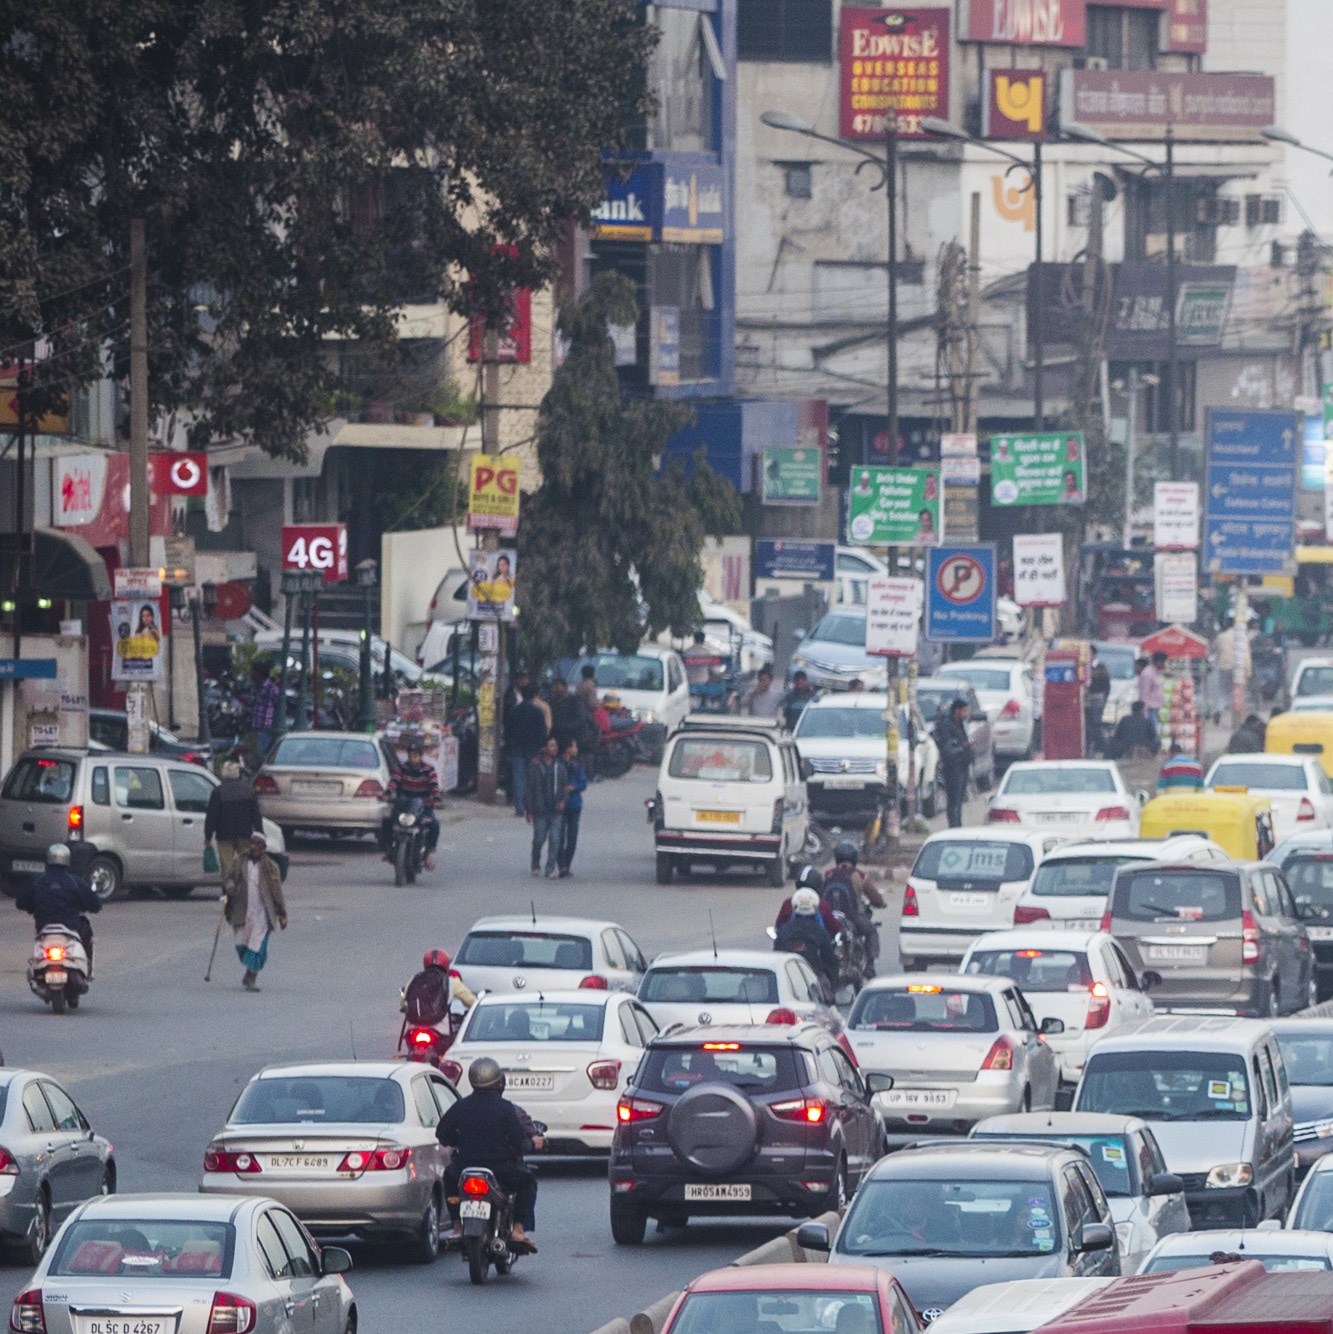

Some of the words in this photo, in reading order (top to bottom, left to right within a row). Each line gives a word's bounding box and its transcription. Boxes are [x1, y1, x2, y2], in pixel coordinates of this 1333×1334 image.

[851, 28, 939, 58] EDWISE
[851, 61, 939, 76] OVERSEAS
[851, 78, 939, 92] EDUCATION
[590, 192, 645, 222] ank
[475, 465, 518, 496] PG
[287, 537, 334, 569] 4G
[933, 611, 948, 621] No
[949, 611, 989, 624] Parking
[965, 847, 1005, 876] jms
[690, 1186, 750, 1199] HR05AM4959
[90, 1323, 104, 1334] DL
[122, 1322, 131, 1334] D
[133, 1322, 161, 1334] 4267
